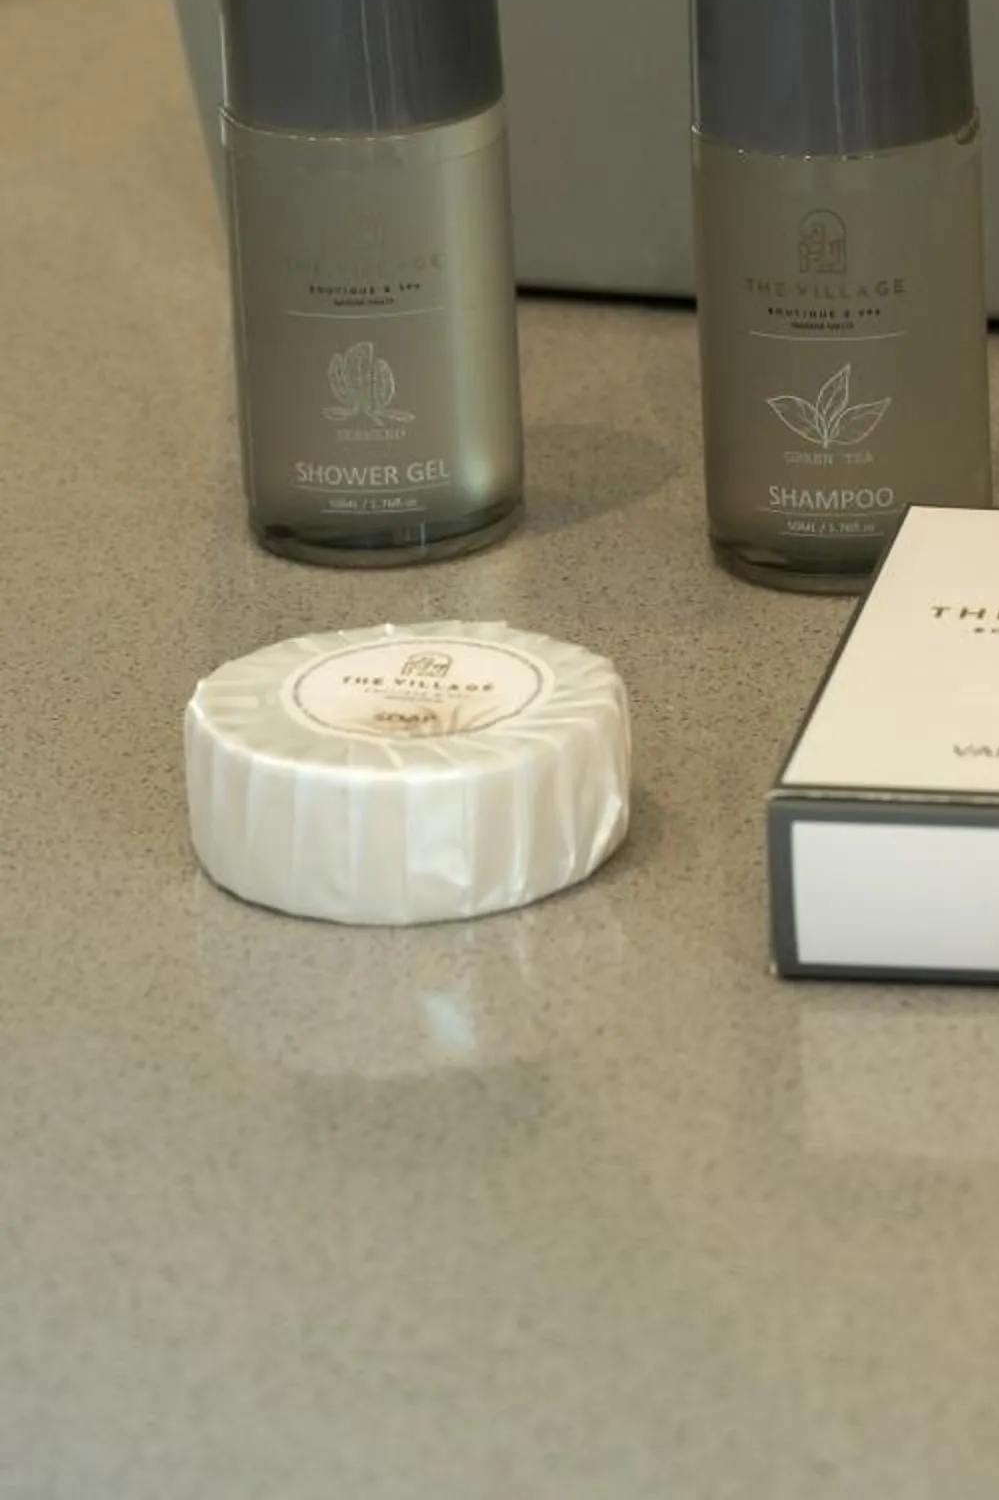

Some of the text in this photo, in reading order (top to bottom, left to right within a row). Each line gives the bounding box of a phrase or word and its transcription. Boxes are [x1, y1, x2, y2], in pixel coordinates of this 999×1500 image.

[744, 277, 907, 301] THE VILLAGE
[293, 458, 451, 487] SHOWER GEL
[768, 484, 895, 511] SHAMPOO
